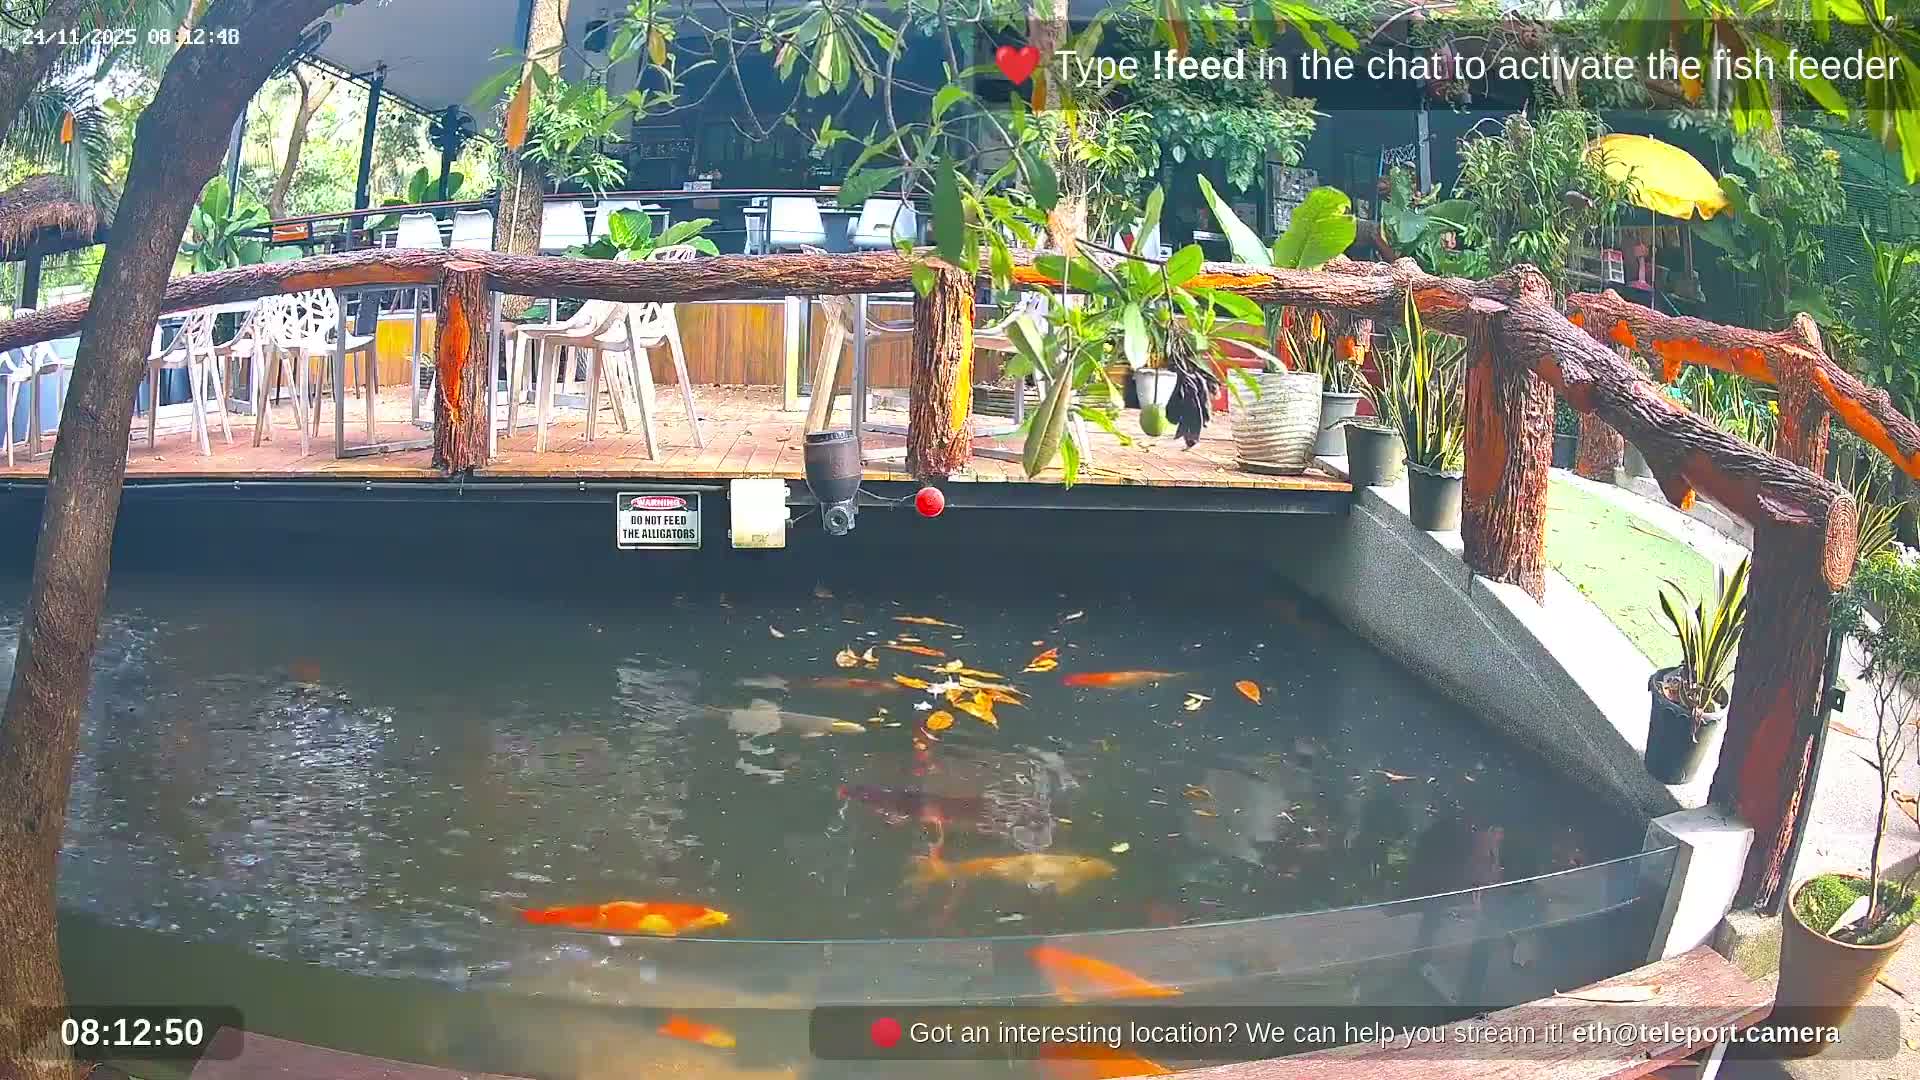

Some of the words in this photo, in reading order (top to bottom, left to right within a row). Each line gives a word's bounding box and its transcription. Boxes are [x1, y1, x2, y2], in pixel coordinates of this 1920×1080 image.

[637, 498, 681, 507] WARNING
[631, 515, 643, 526] DO
[645, 515, 662, 526] NOT
[664, 515, 687, 526] FEED
[623, 528, 640, 539] THE
[642, 528, 695, 539] ALLIGATORS
